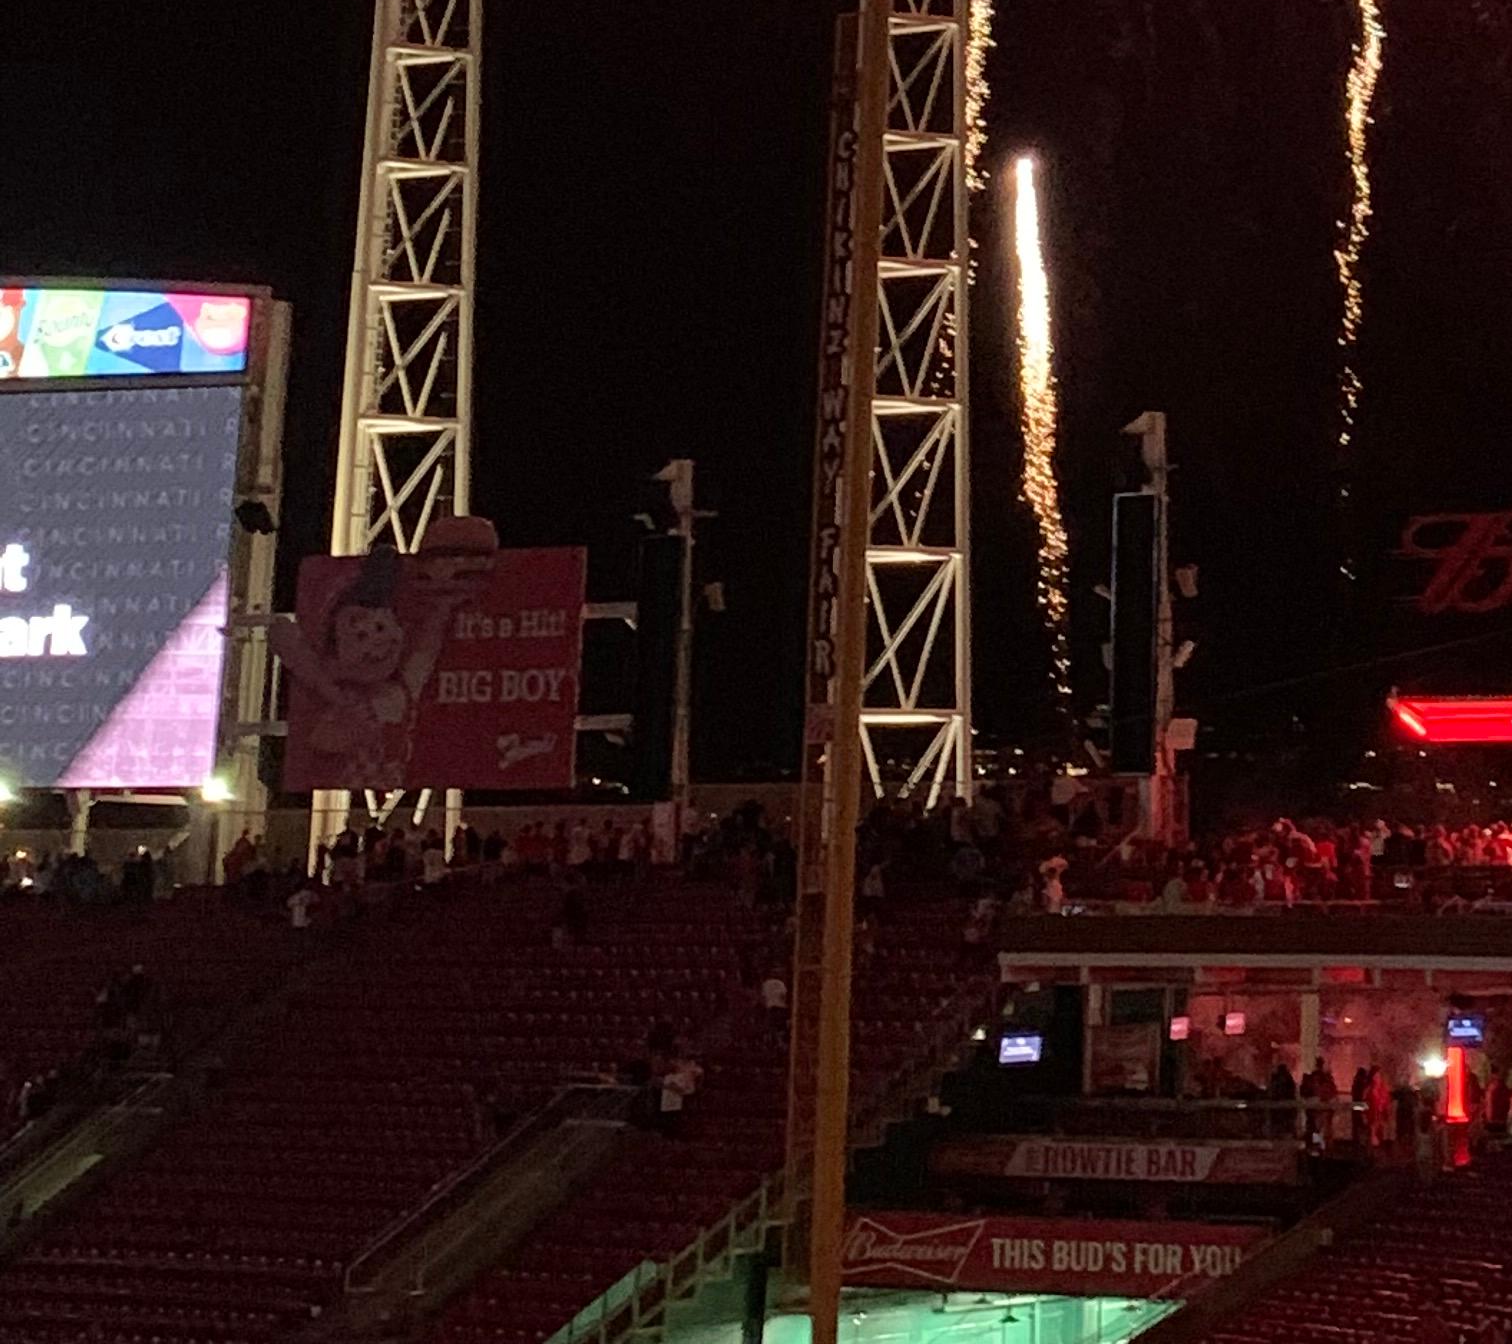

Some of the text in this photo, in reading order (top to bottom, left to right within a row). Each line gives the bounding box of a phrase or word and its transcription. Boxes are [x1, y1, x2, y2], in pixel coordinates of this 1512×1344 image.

[455, 612, 494, 639] It's
[438, 668, 566, 703] BIG BOY
[1147, 1148, 1197, 1177] BAR
[992, 1239, 1045, 1270] THIS
[1053, 1240, 1127, 1273] BUD'S
[1135, 1243, 1183, 1275] FOR
